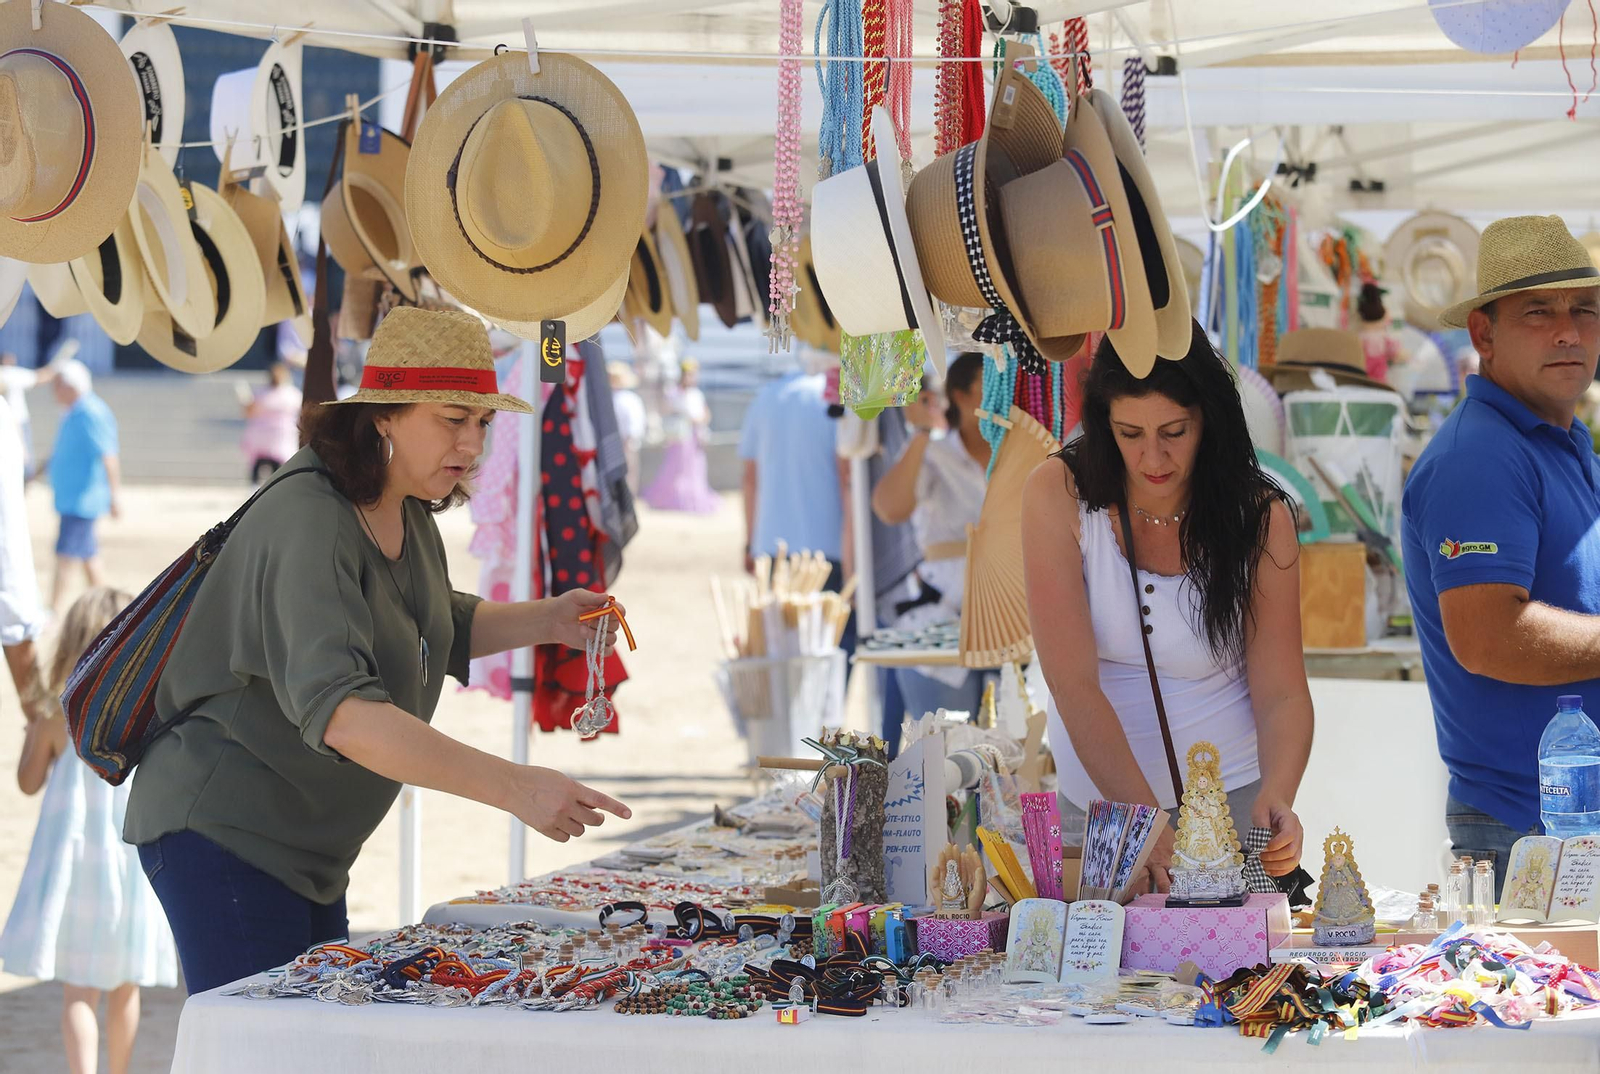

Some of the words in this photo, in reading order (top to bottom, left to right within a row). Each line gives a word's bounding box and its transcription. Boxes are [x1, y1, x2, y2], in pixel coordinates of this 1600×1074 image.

[378, 372, 401, 380] DYC
[1541, 786, 1570, 795] TECELTA
[885, 845, 922, 854] PEN-FLUTE
